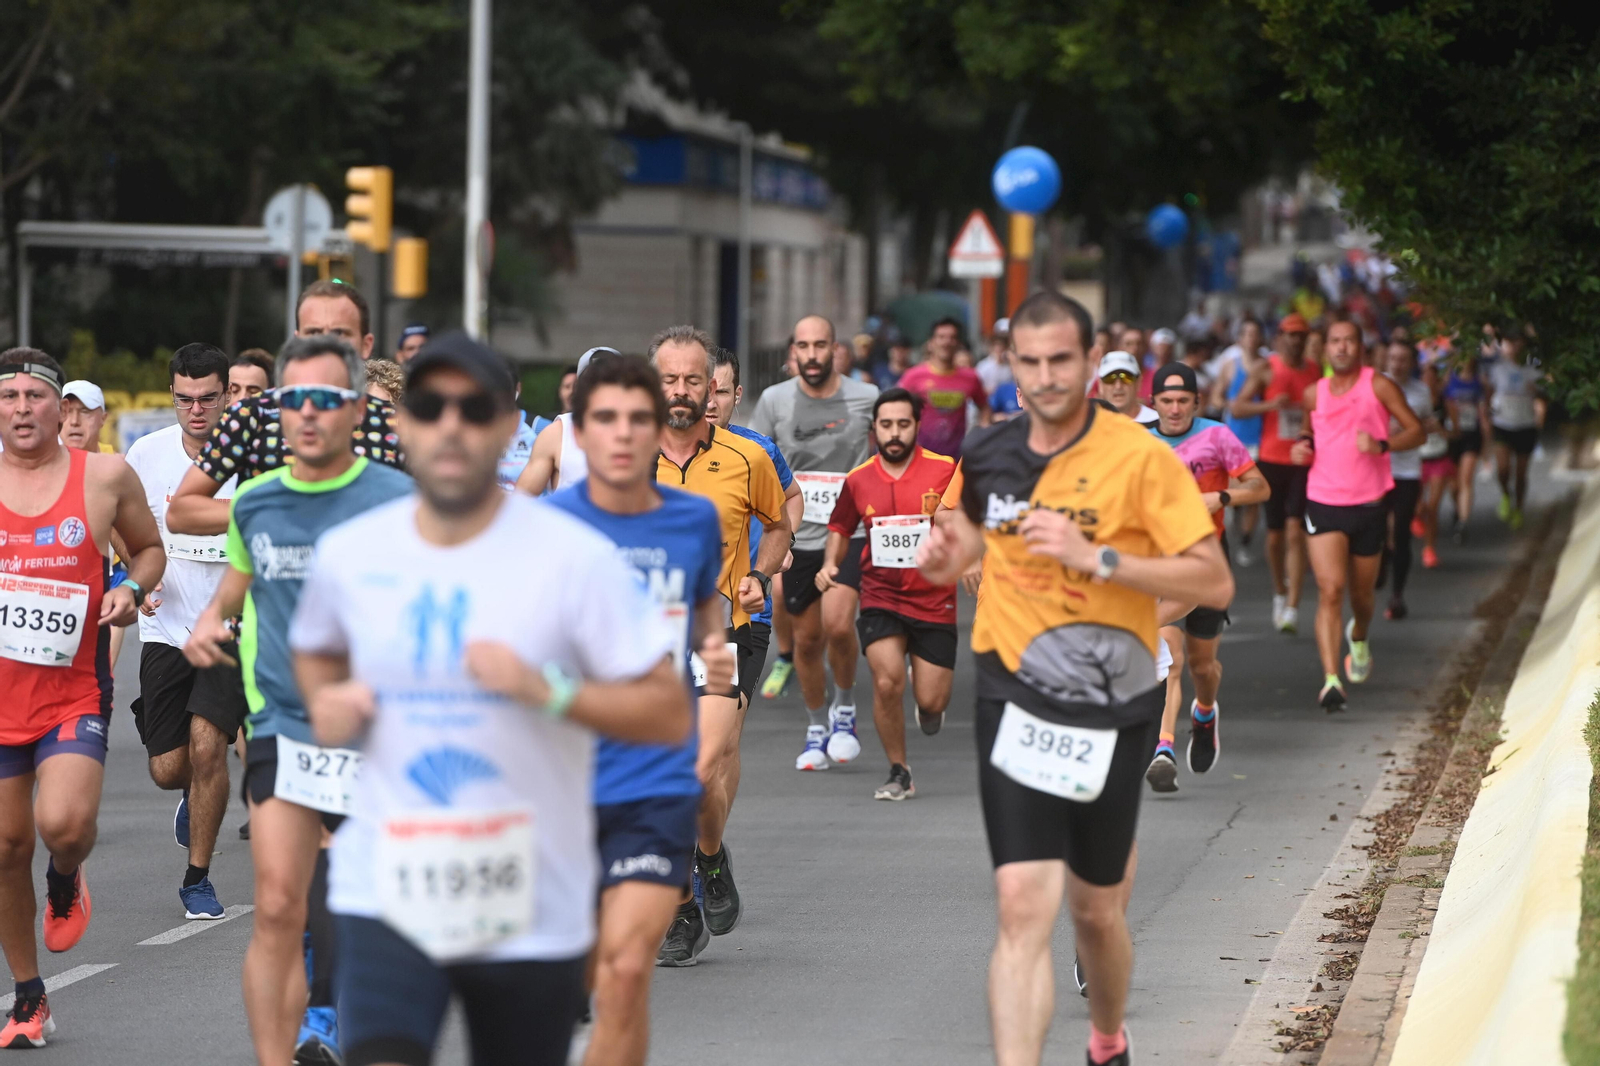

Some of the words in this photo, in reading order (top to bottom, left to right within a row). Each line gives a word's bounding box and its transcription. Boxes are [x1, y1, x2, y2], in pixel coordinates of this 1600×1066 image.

[882, 533, 921, 548] 3887
[25, 556, 78, 569] FERTILIDAD
[0, 604, 77, 635] 13359
[1020, 723, 1093, 764] 3982
